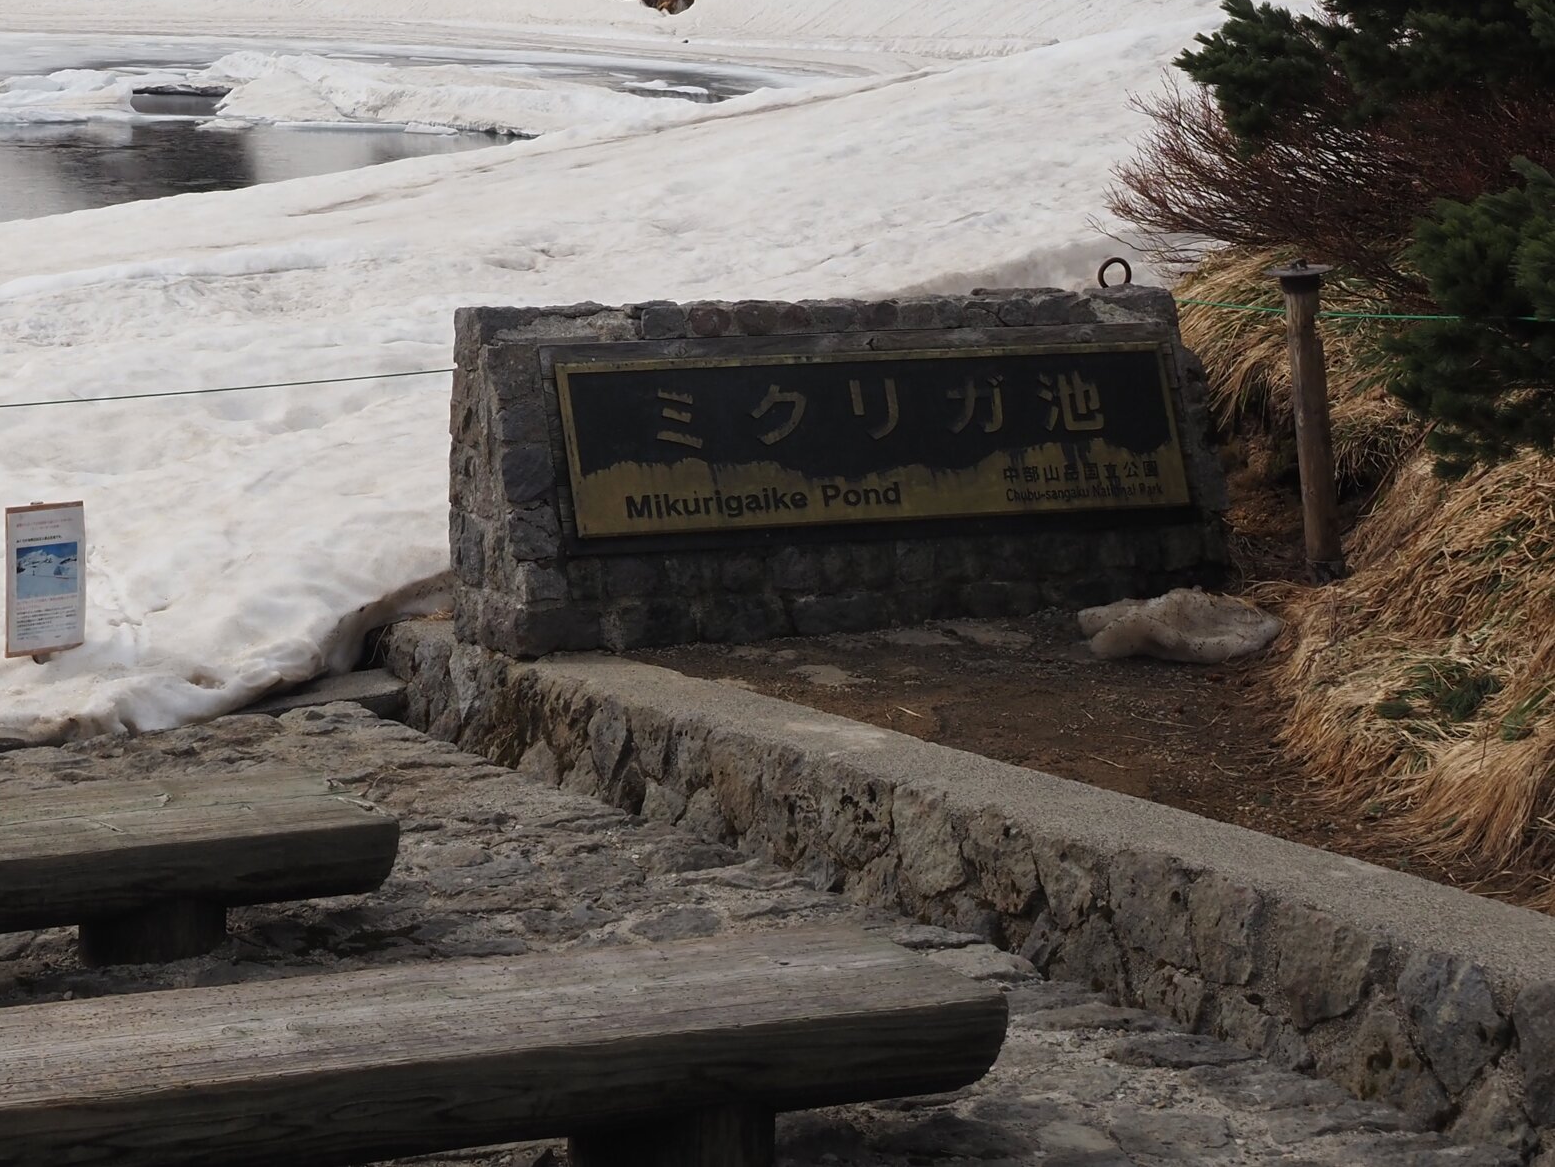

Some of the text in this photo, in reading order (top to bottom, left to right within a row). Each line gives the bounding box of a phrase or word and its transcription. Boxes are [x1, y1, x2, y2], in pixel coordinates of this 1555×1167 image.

[654, 369, 1105, 450] ミクリガ池
[625, 481, 903, 520] Mikurigaike Pond
[1092, 483, 1136, 500] Natinal
